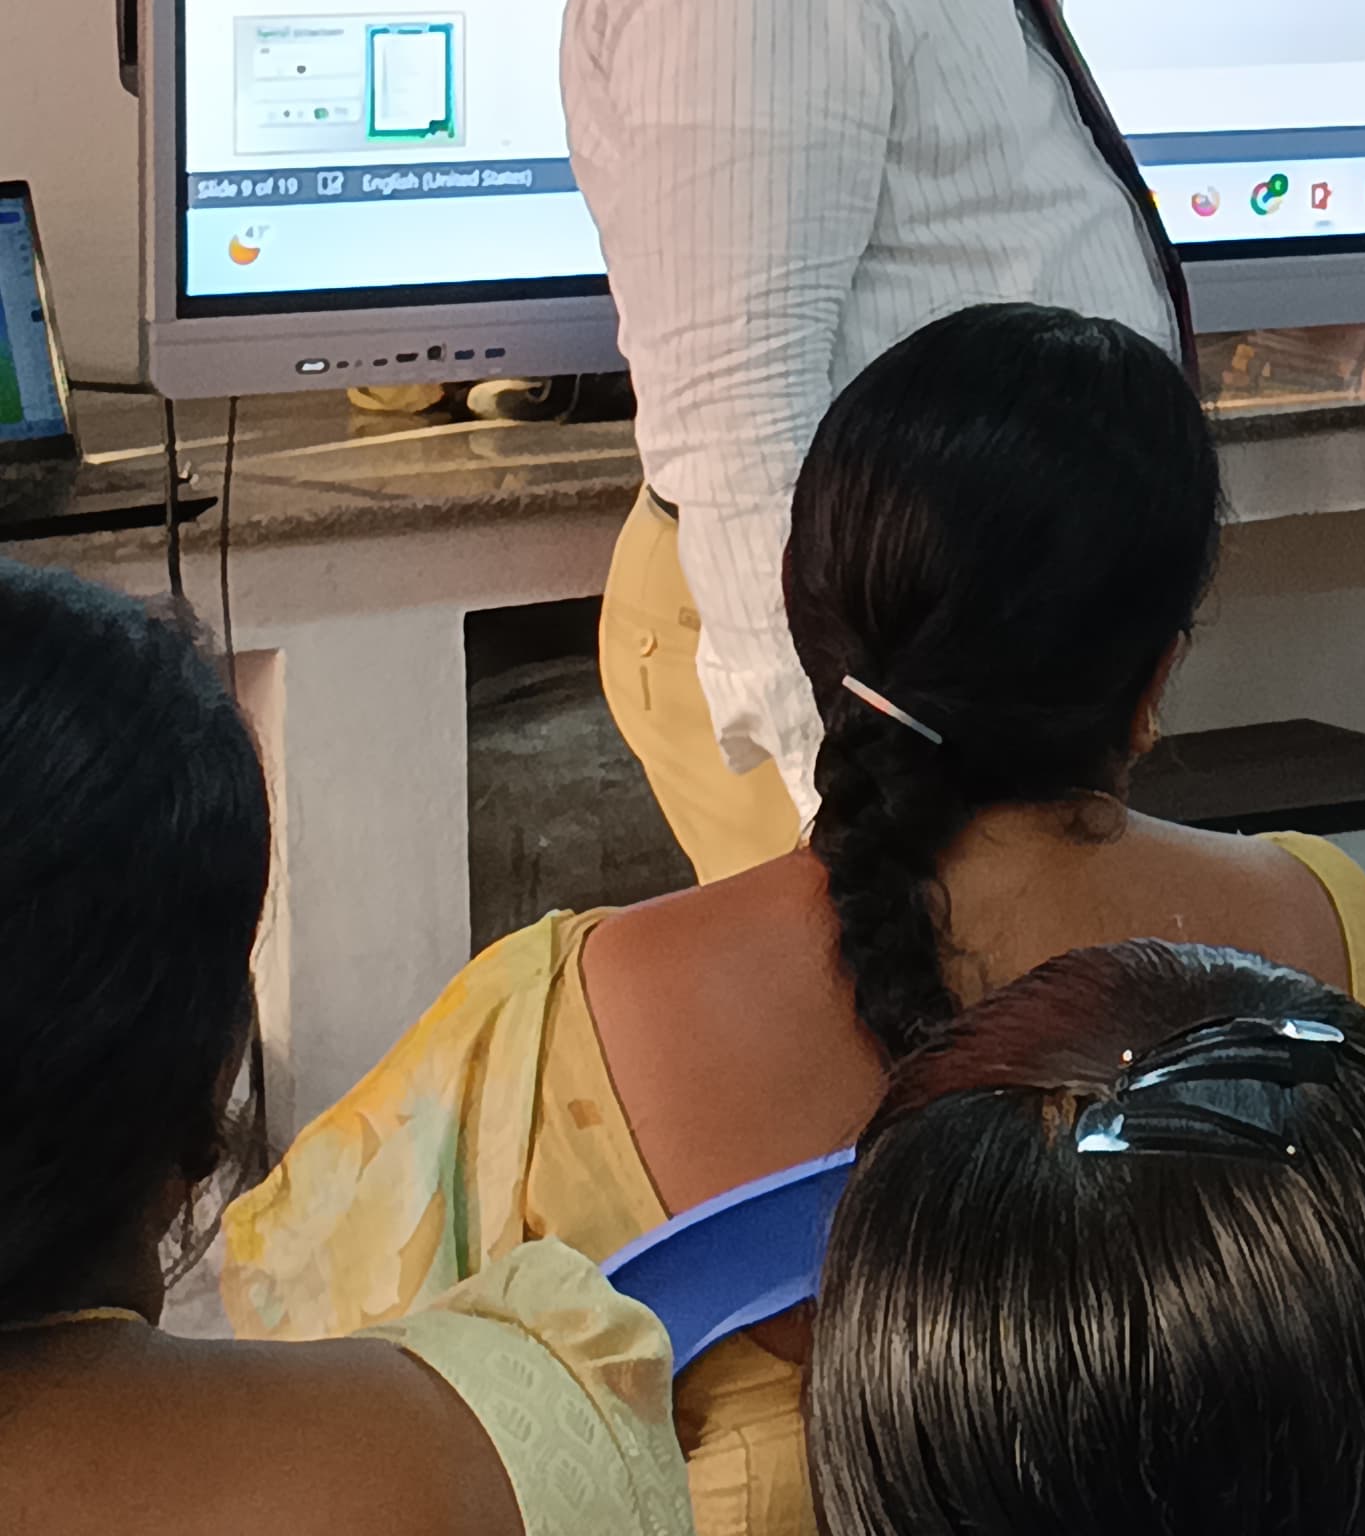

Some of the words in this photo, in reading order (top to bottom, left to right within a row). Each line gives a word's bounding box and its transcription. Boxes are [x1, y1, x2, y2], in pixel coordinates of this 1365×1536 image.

[197, 178, 239, 200] Slide
[241, 179, 253, 197] 9
[255, 176, 274, 197] of
[277, 177, 299, 195] 19
[362, 170, 420, 196] English
[423, 168, 480, 192] (United
